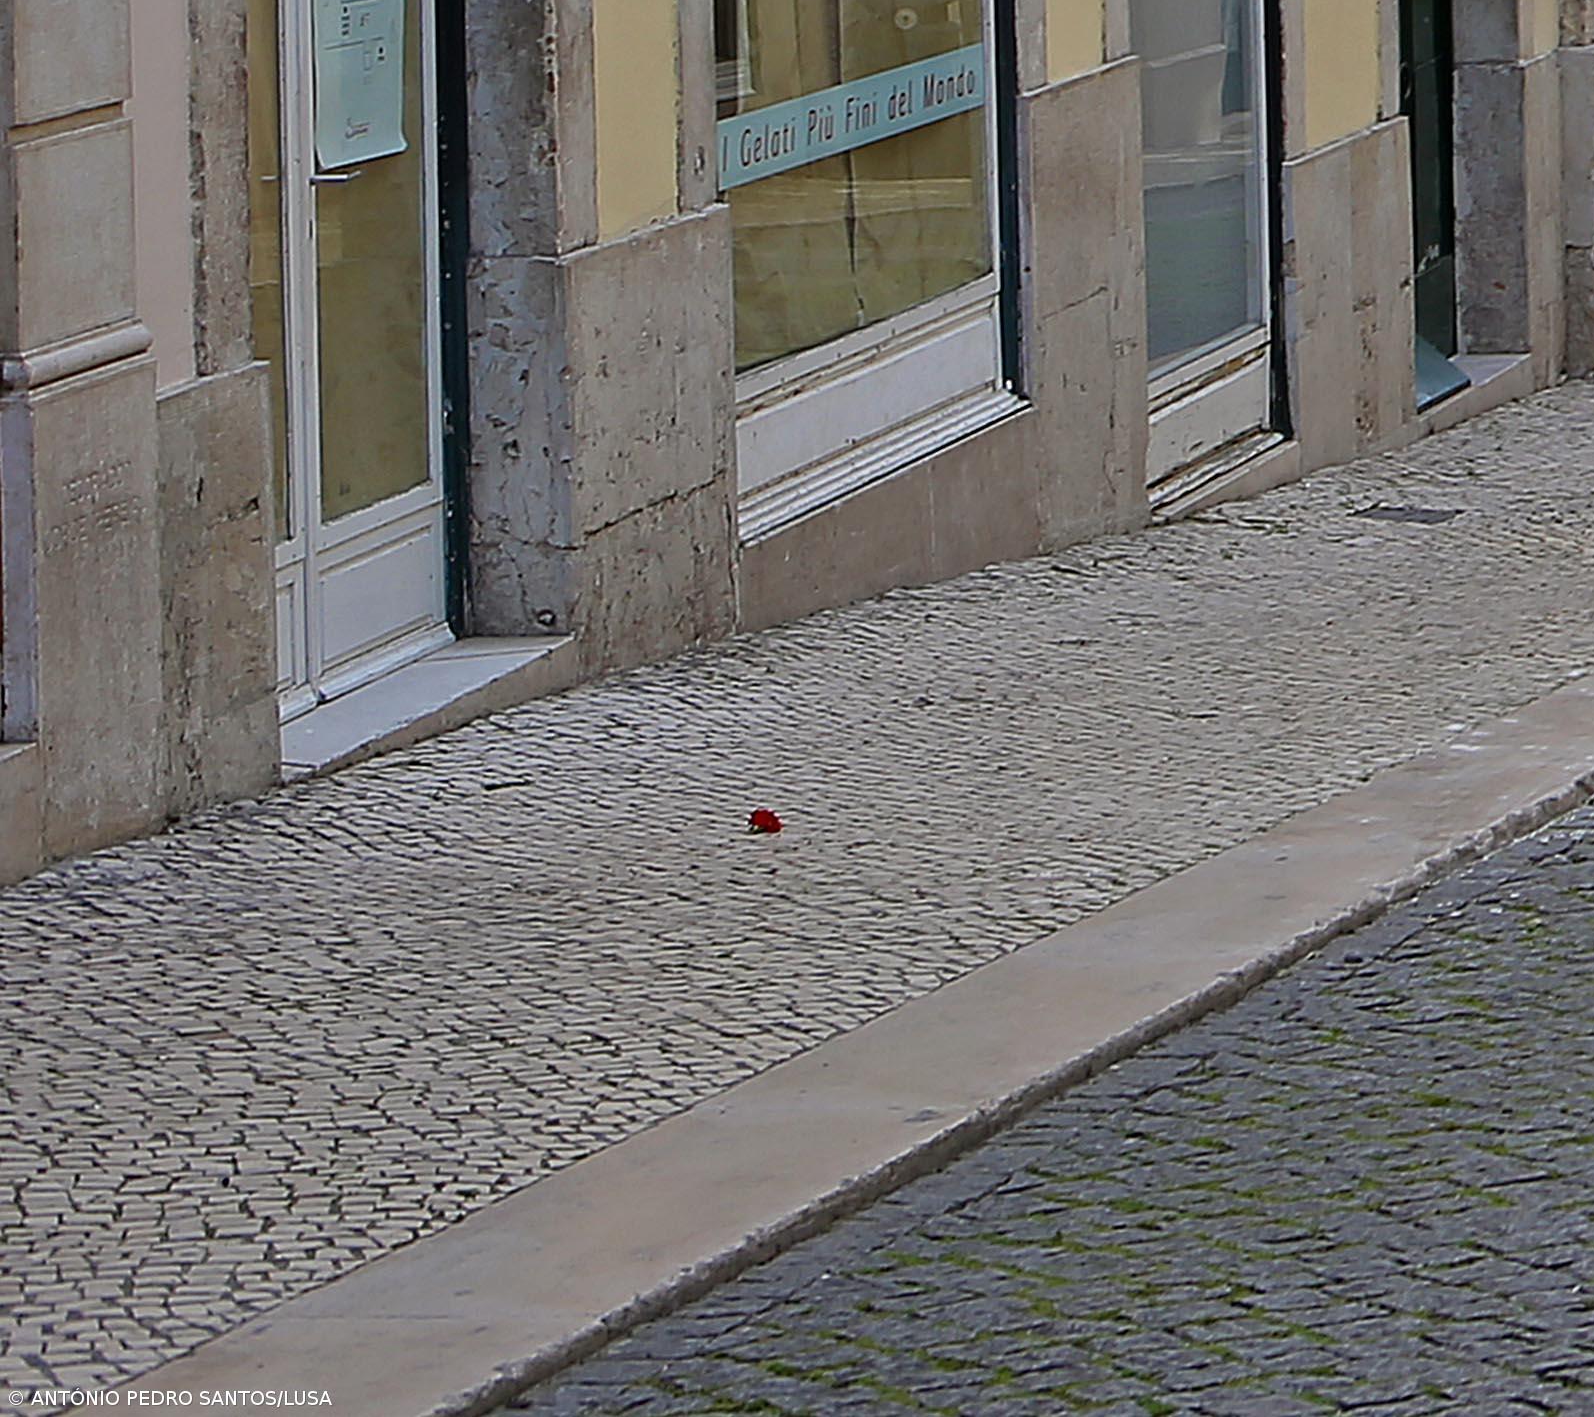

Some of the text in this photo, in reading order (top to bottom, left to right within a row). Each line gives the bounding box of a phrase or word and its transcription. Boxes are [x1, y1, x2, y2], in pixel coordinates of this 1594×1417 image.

[739, 118, 796, 167] Gelati
[807, 107, 834, 147] Più
[845, 91, 878, 134] Fini
[888, 80, 913, 121] del
[923, 65, 976, 108] Mondo
